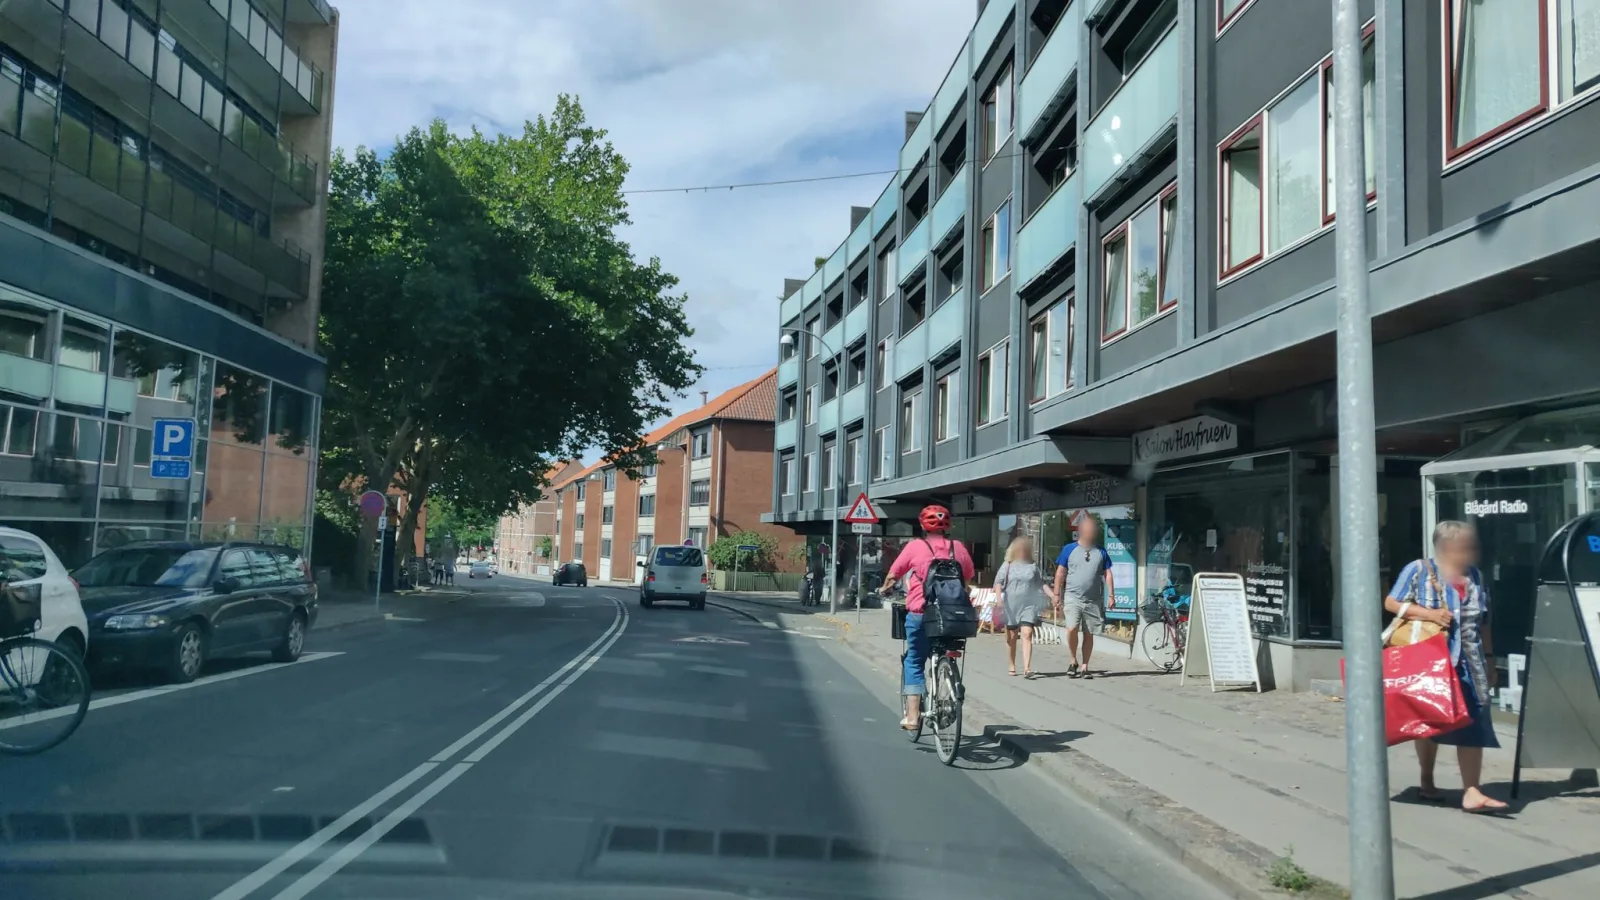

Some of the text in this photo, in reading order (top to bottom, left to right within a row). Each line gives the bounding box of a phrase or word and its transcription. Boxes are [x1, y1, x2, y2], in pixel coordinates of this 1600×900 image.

[163, 425, 185, 452] P
[1464, 499, 1528, 517] Blågård Radio
